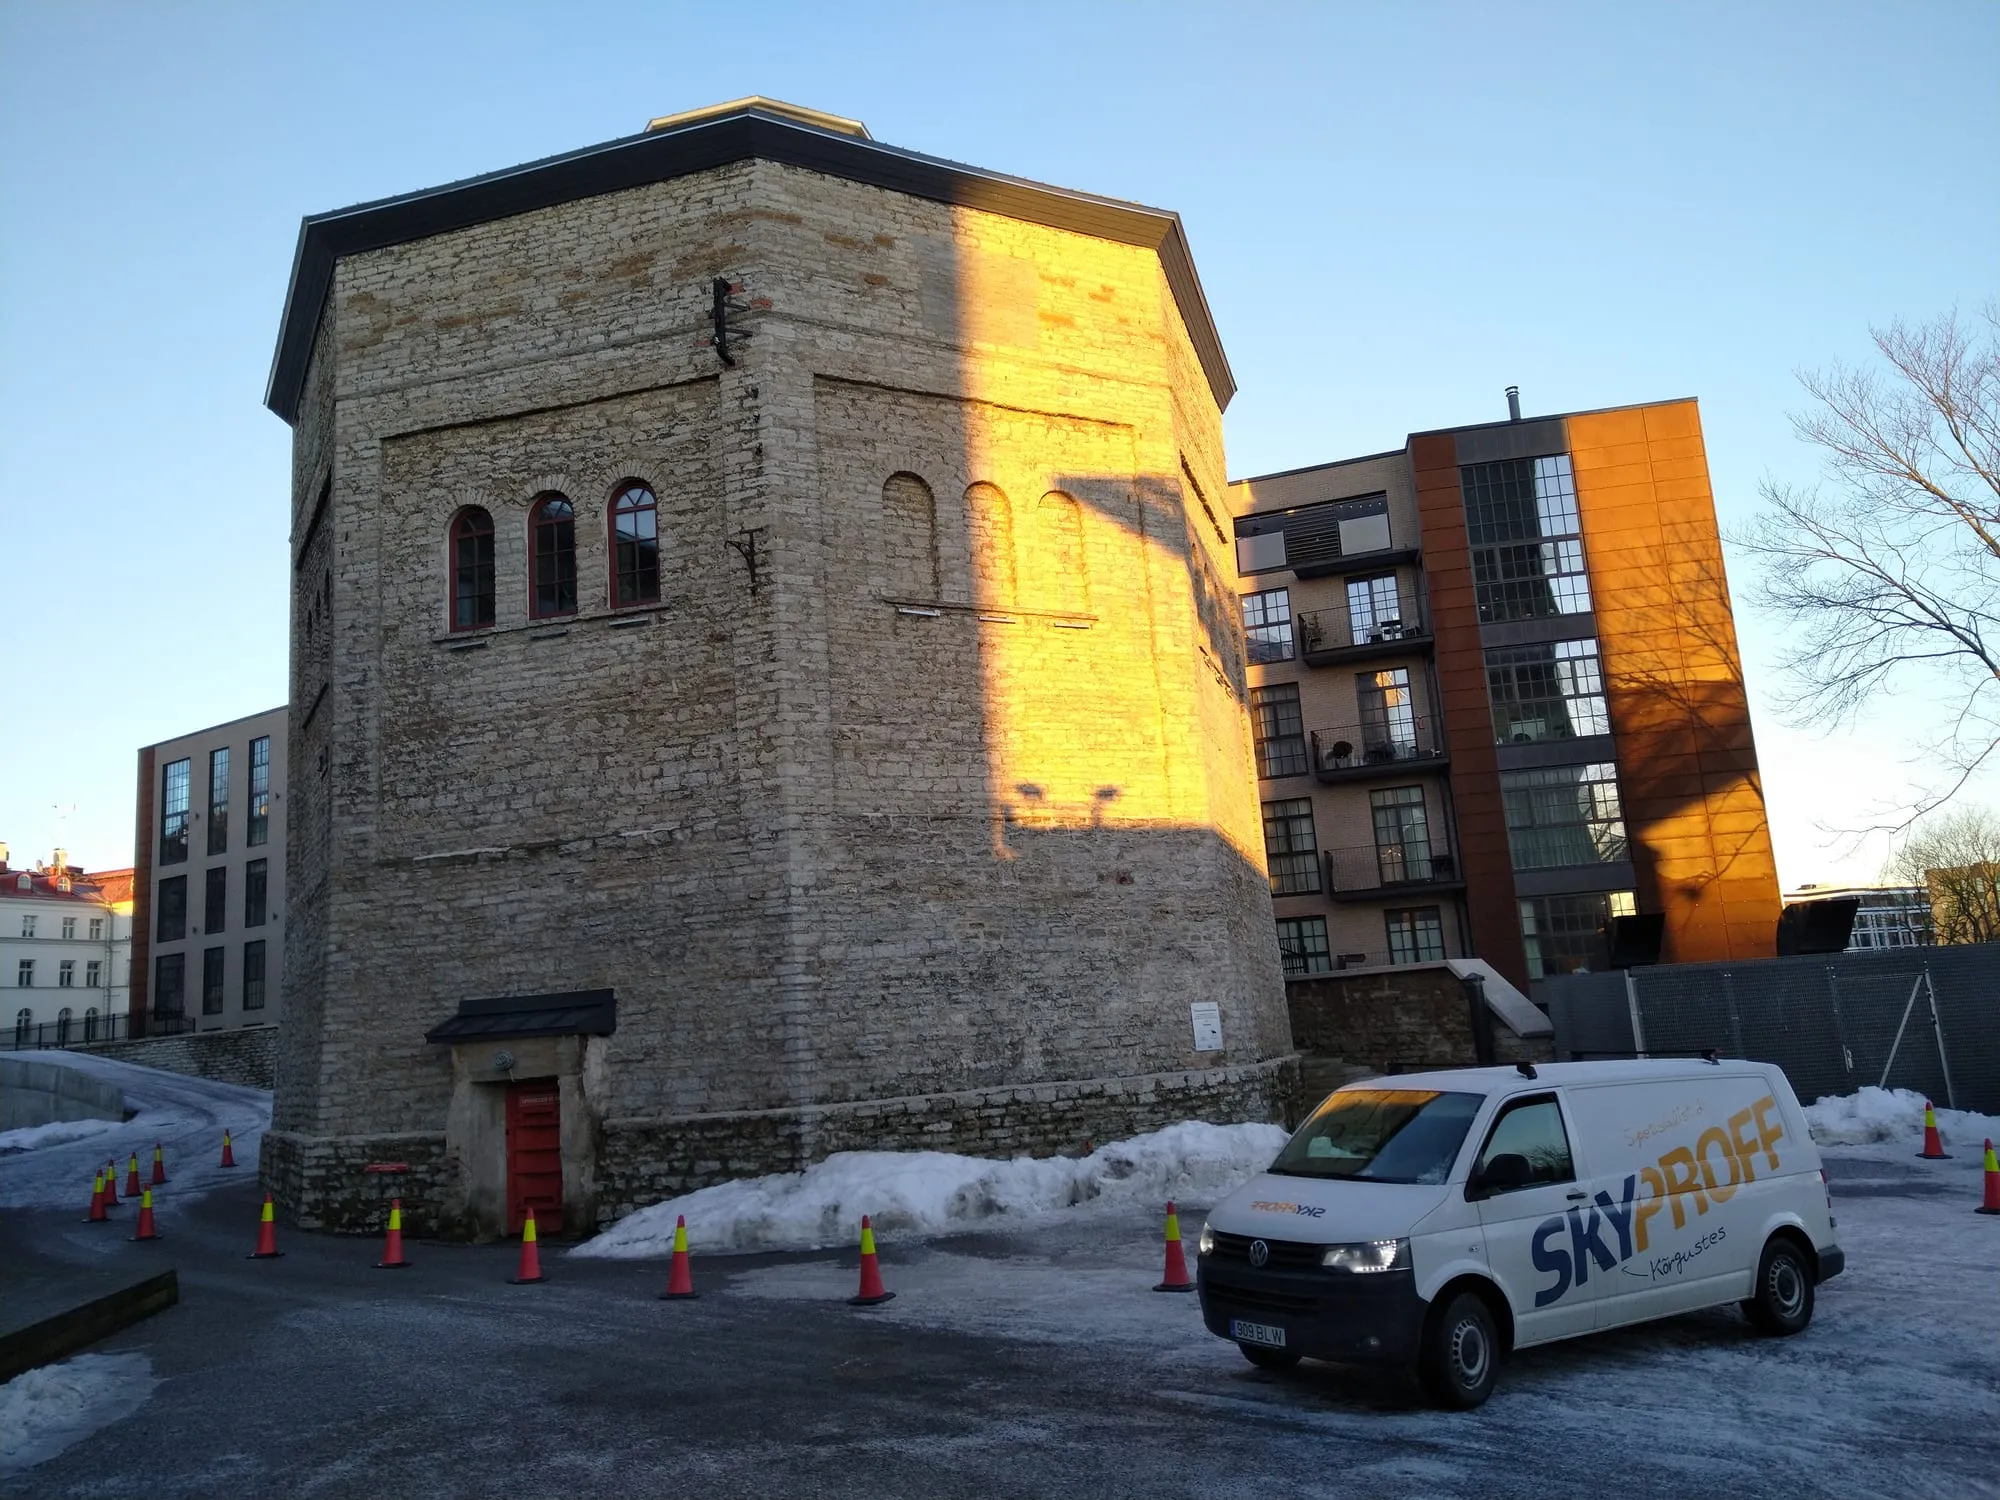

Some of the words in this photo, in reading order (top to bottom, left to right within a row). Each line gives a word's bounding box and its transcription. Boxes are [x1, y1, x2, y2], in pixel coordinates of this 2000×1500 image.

[1532, 1095, 1783, 1308] SKYPROFF
[1649, 1226, 1727, 1281] Kõrgustes
[1236, 1322, 1254, 1338] 909
[1256, 1325, 1282, 1345] BLW
